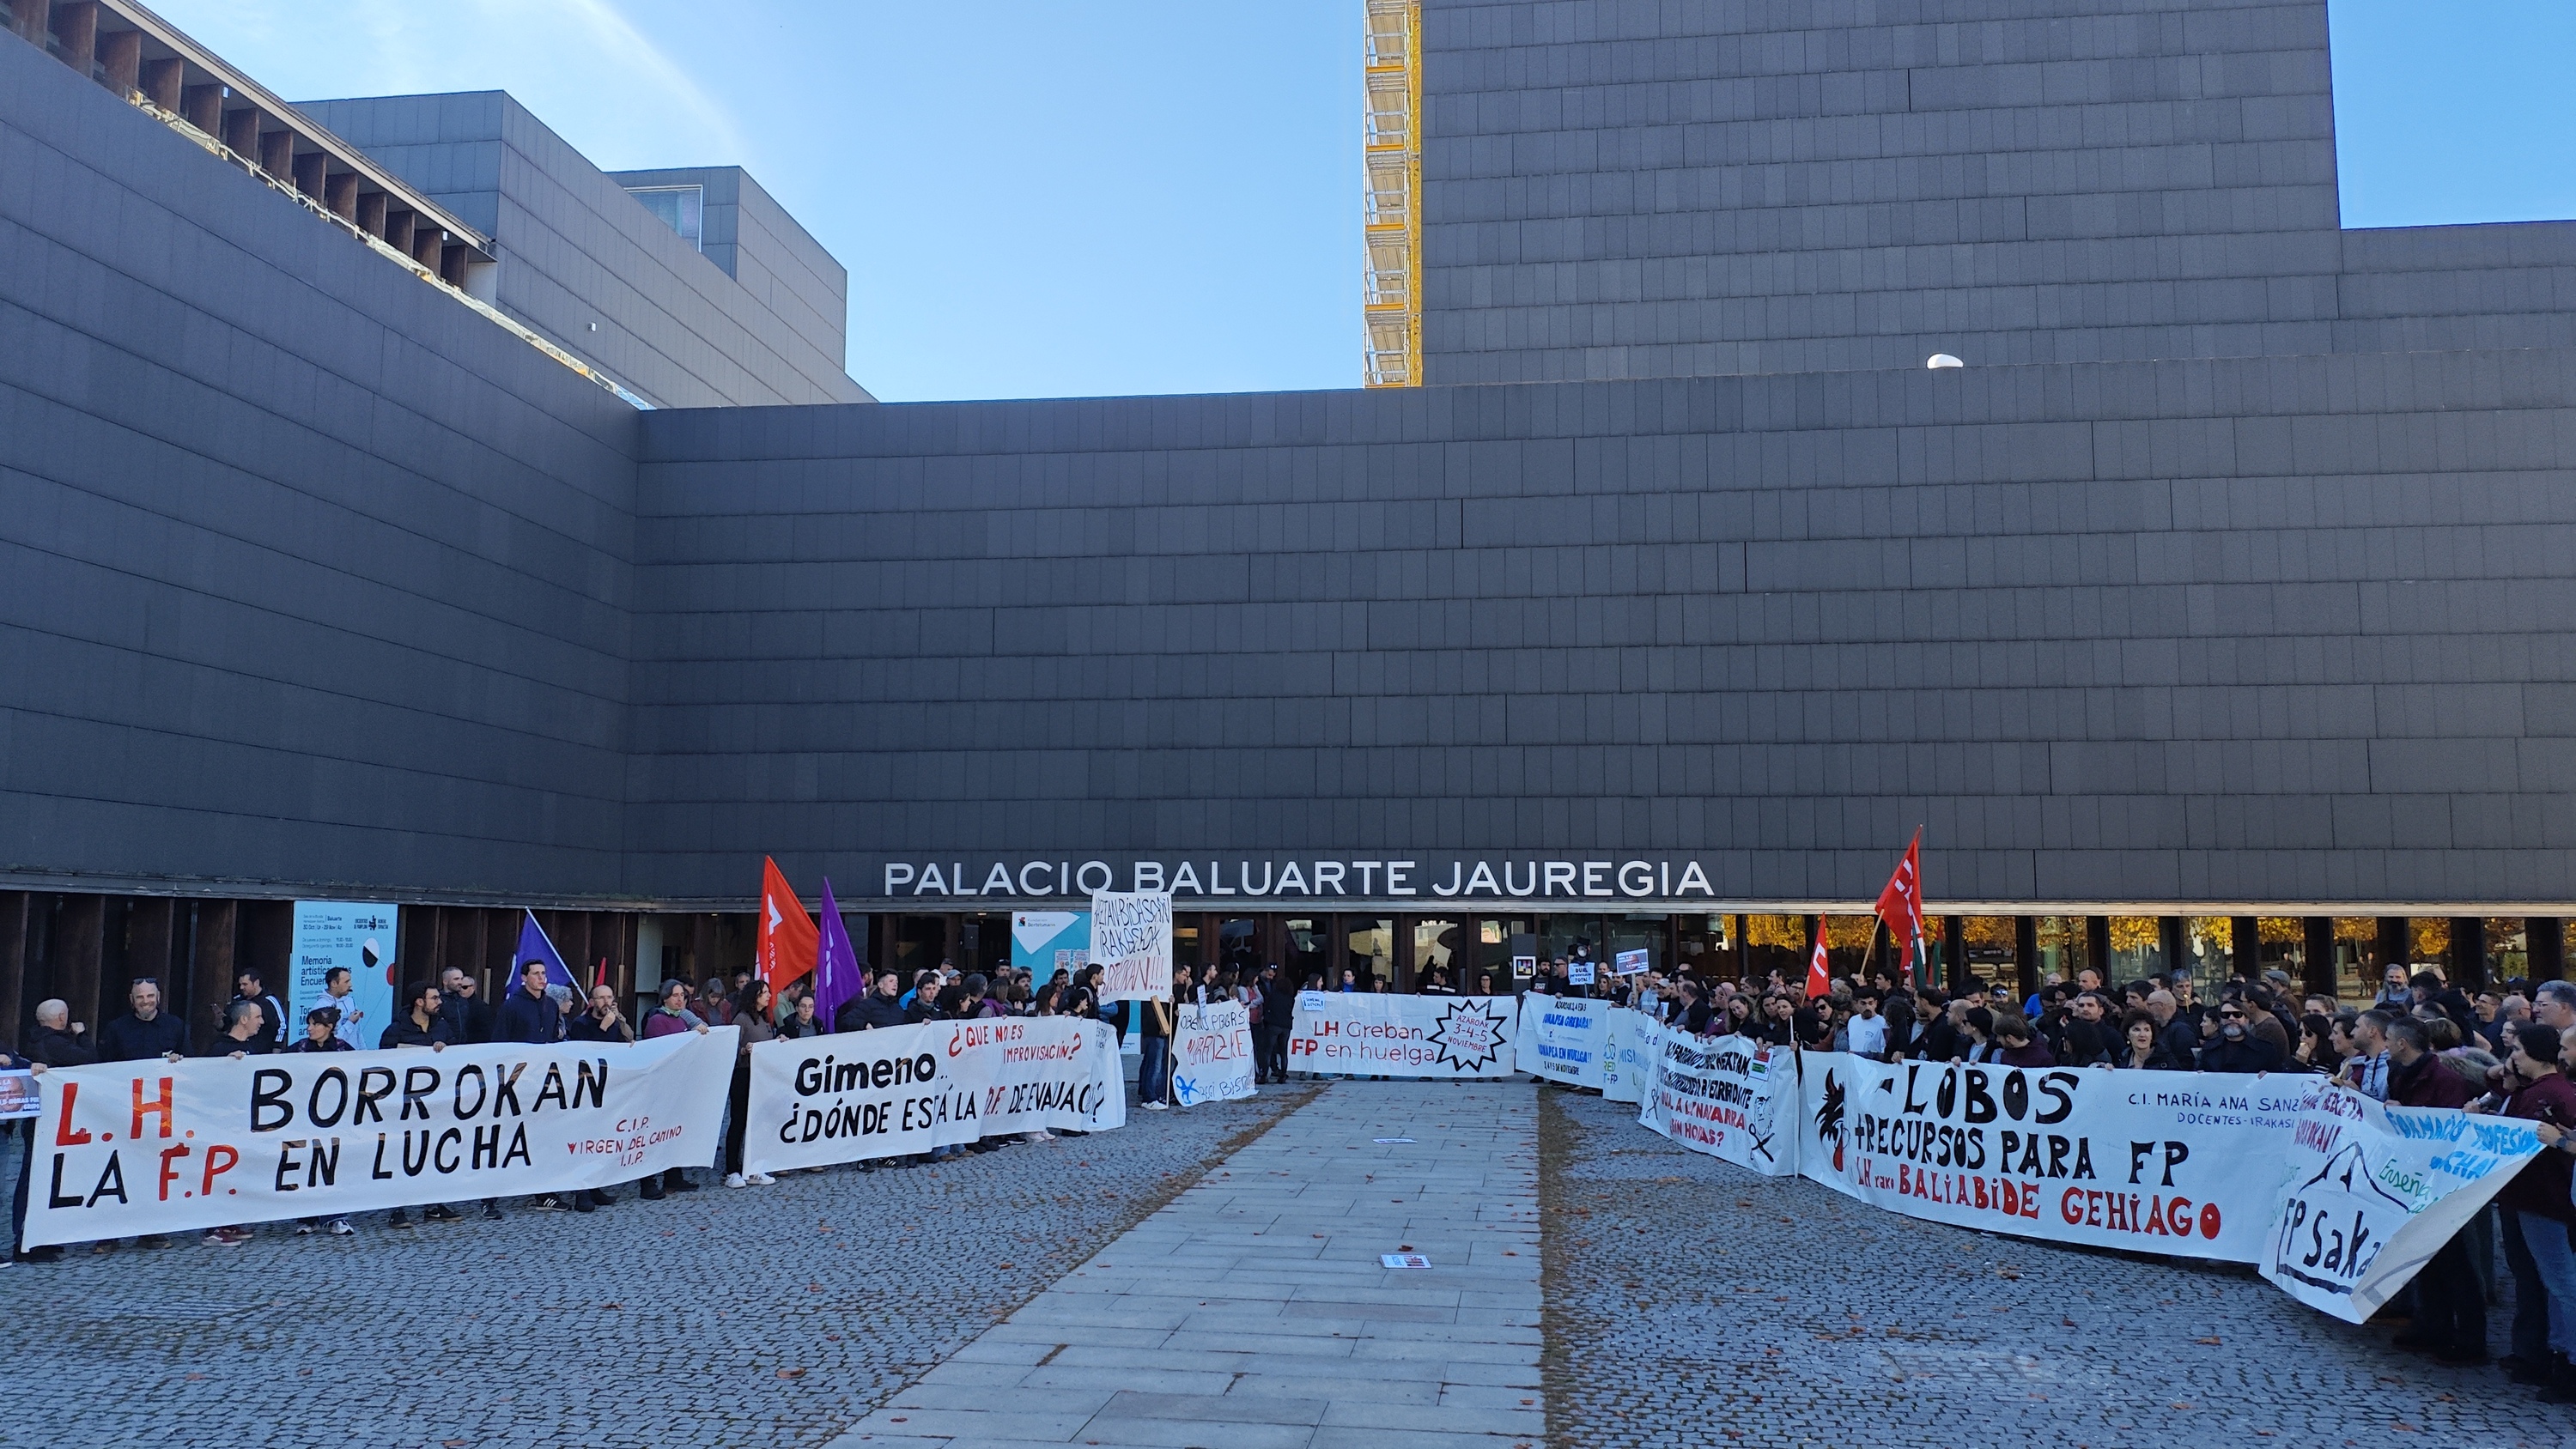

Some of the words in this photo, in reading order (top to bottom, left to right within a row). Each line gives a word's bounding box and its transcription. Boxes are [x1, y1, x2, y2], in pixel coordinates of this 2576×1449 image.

[884, 861, 1113, 896] PALACIO
[1133, 861, 1416, 896] BALUARTE
[1432, 861, 1715, 896] JAUREGIA
[301, 955, 332, 965] Memoria
[995, 1025, 1009, 1043] NO
[1011, 1024, 1024, 1040] ES
[1314, 1021, 1339, 1037] LH
[1346, 1021, 1424, 1040] Greban
[1453, 1023, 1488, 1042] 3-4-5
[1456, 1014, 1490, 1029] AZAROAK
[1291, 1038, 1319, 1056] FP
[1325, 1045, 1352, 1059] en
[1359, 1040, 1436, 1065] huelga
[1447, 1035, 1487, 1053] NOVIEMBRE
[251, 1058, 608, 1133] BORROKAN
[2129, 1093, 2151, 1106] C.I.
[2157, 1091, 2212, 1107] MARÍA
[2219, 1096, 2249, 1111] ANA
[2257, 1097, 2300, 1112] SANZ
[616, 1116, 649, 1132] C.I.P.
[779, 1097, 892, 1143] ¿DÓNDE
[955, 1090, 977, 1121] LA
[1007, 1083, 1028, 1115] DE
[567, 1139, 623, 1155] VIRGEN
[628, 1136, 646, 1150] DEL
[649, 1125, 682, 1145] CAMINO
[1855, 1113, 1985, 1170] +RECURSOS
[2001, 1130, 2097, 1179] PARA
[2129, 1140, 2190, 1187] FP
[49, 1149, 128, 1210] LA
[159, 1142, 240, 1202] F.P.
[276, 1137, 341, 1191] EN
[372, 1121, 532, 1180] LUCHA
[1856, 1156, 1872, 1188] LH
[2277, 1197, 2307, 1266] FP
[2303, 1210, 2386, 1279] Saka
